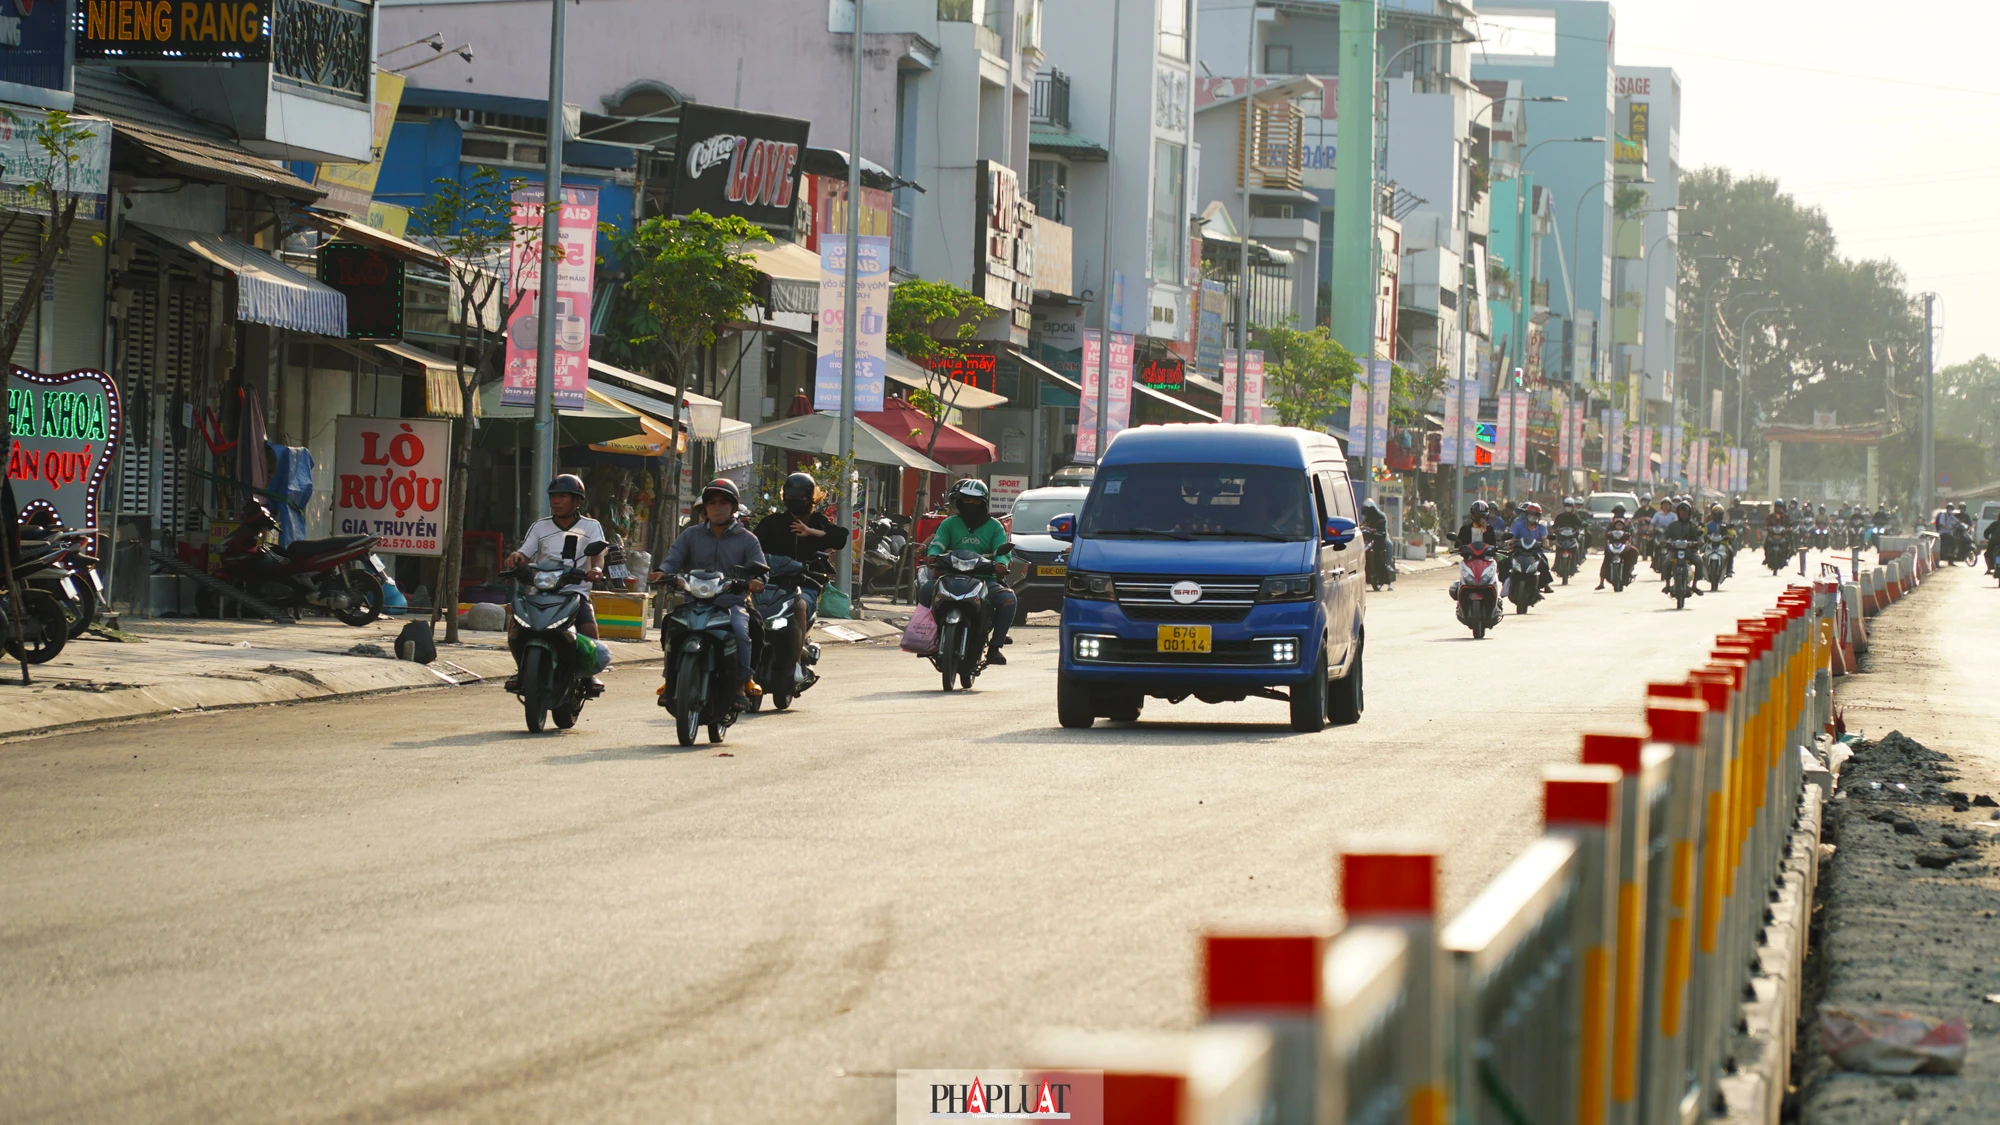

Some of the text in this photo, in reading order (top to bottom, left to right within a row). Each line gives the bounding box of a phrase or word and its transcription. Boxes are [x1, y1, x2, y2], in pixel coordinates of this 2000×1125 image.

[687, 134, 798, 208] Coffee LOVE
[8, 389, 106, 441] HA KHOA
[360, 423, 425, 467] LÒ
[44, 444, 93, 491] QUÝ
[998, 479, 1020, 488] SPORT
[339, 468, 442, 519] RƯỢU
[342, 516, 437, 538] GIA TRUYỀN
[961, 536, 981, 545] Grab
[1164, 639, 1205, 651] 001.14
[1173, 627, 1197, 638] 67G
